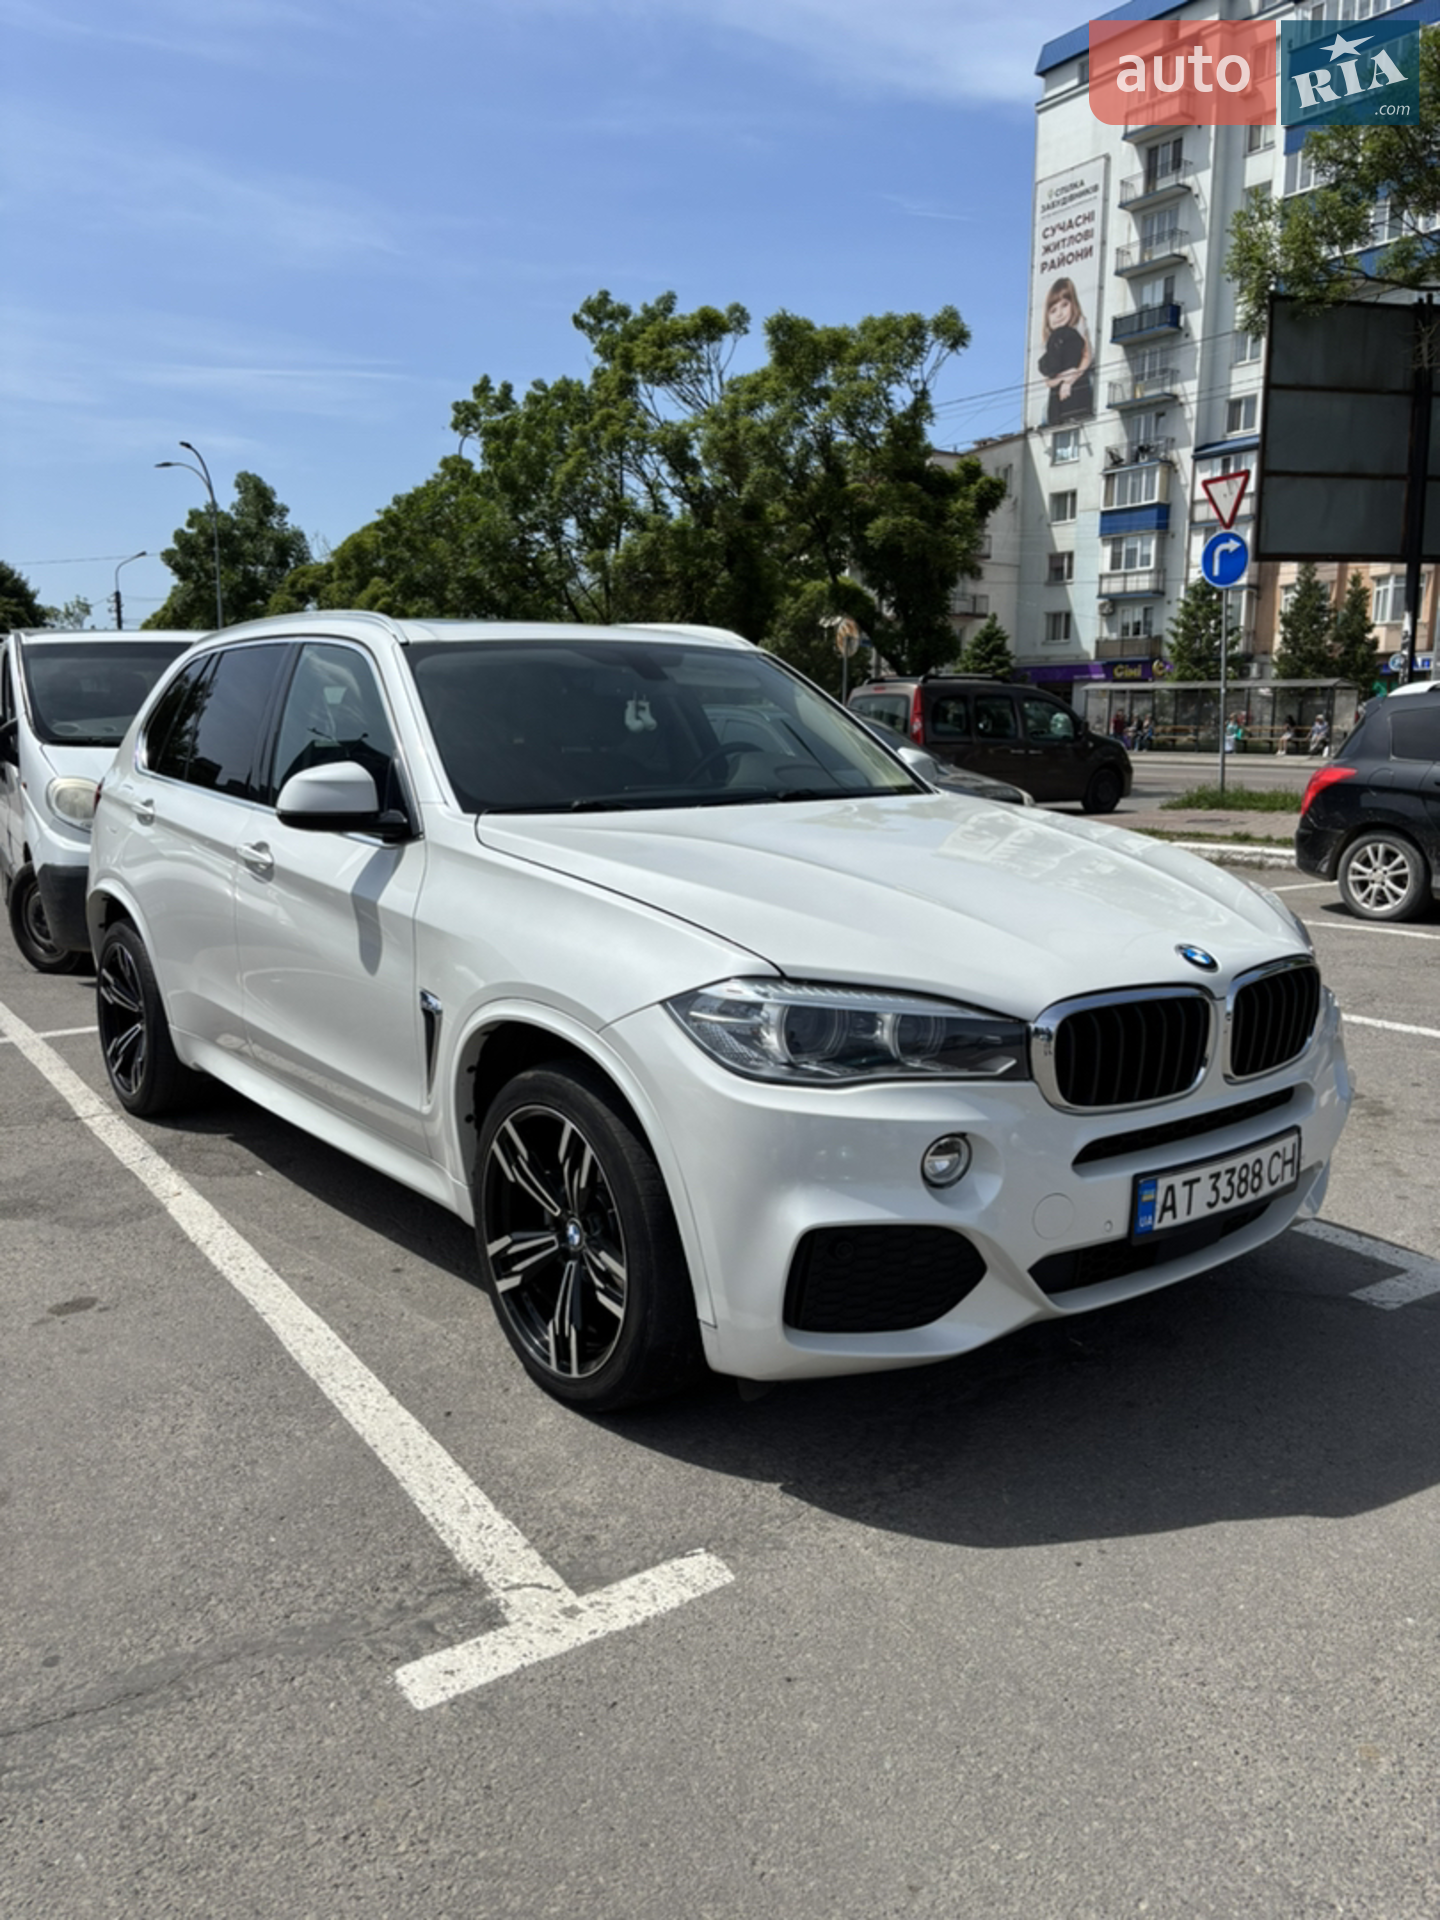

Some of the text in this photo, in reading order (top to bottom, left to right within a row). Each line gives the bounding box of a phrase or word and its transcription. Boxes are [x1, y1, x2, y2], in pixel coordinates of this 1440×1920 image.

[1042, 210, 1095, 239] СУЧАСНІ
[1041, 228, 1095, 256] ЖИТЛОВІ
[1040, 245, 1093, 274] РАЙОНИ
[1158, 1143, 1296, 1224] AT 3388 CH
